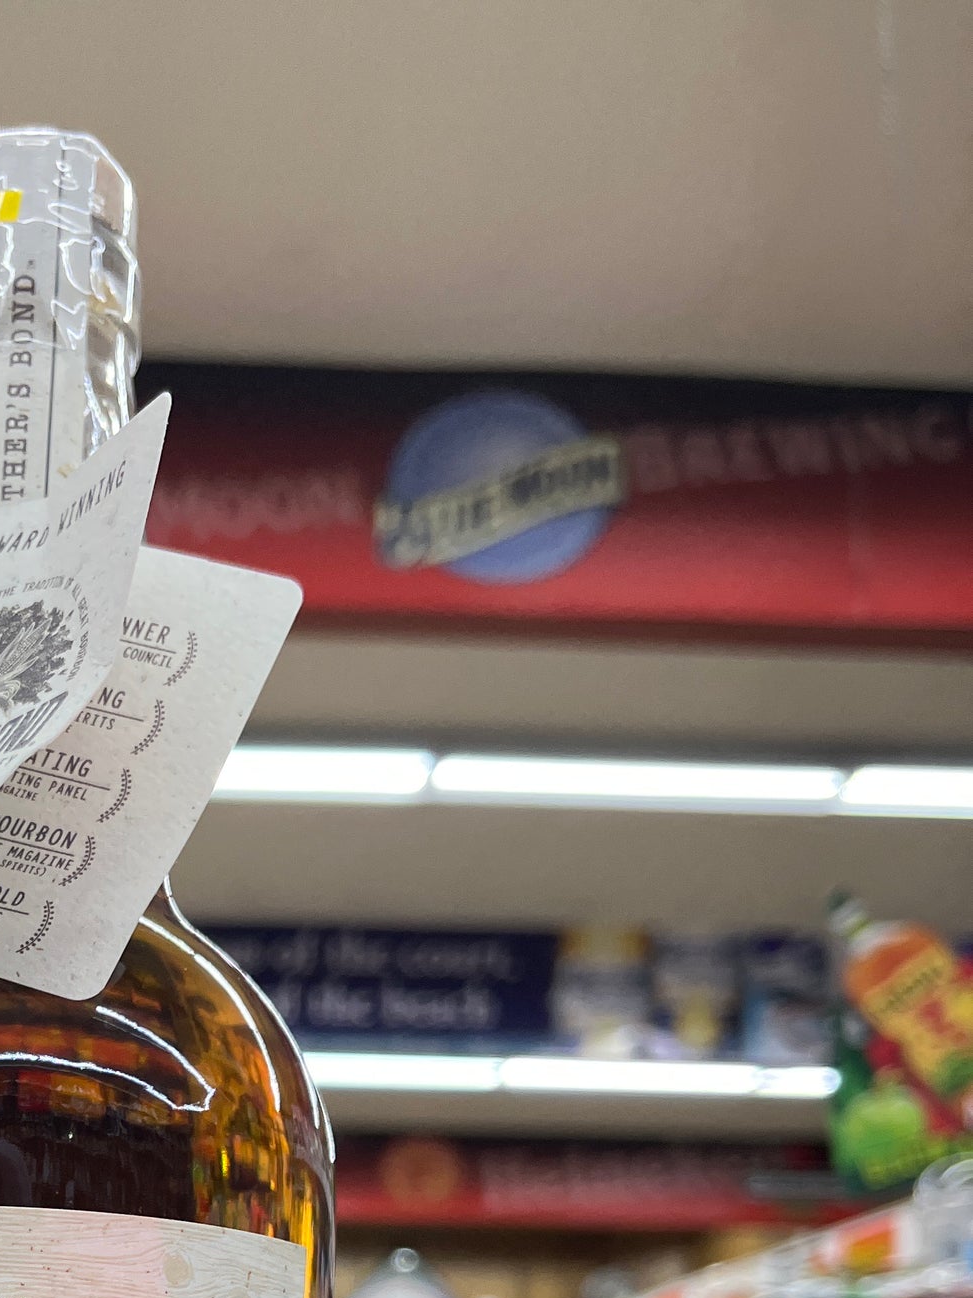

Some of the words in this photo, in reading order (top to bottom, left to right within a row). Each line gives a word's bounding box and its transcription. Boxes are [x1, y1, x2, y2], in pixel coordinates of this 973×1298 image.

[10, 274, 35, 367] BOND
[58, 460, 126, 535] WINNING
[122, 646, 172, 669] COUNCIL
[89, 687, 126, 709] NG
[48, 780, 88, 801] PANEL
[0, 858, 48, 877] SPIRITS)
[6, 845, 75, 871] MAGAZINE
